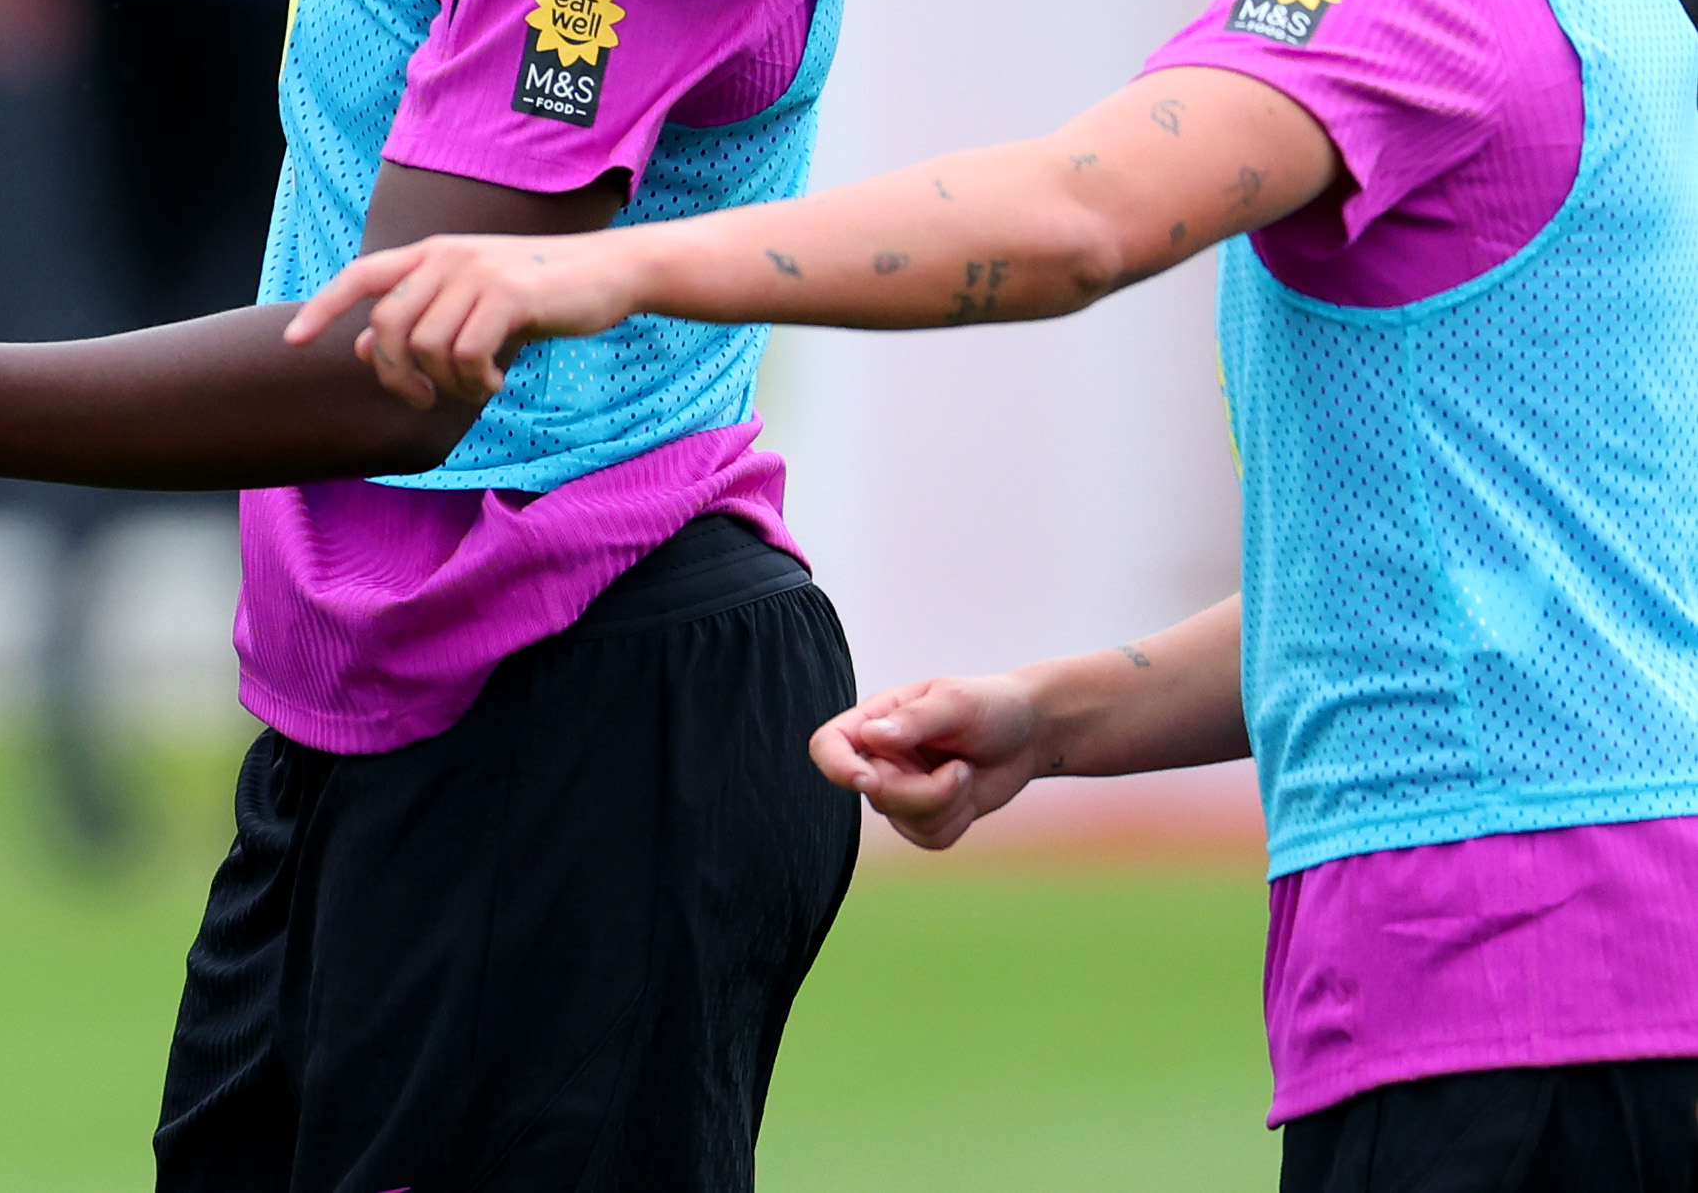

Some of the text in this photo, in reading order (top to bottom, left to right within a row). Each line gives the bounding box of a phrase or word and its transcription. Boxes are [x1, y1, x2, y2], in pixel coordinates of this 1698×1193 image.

[551, 8, 602, 39] well
[525, 63, 596, 104] M&S
[535, 97, 575, 115] FOOD
